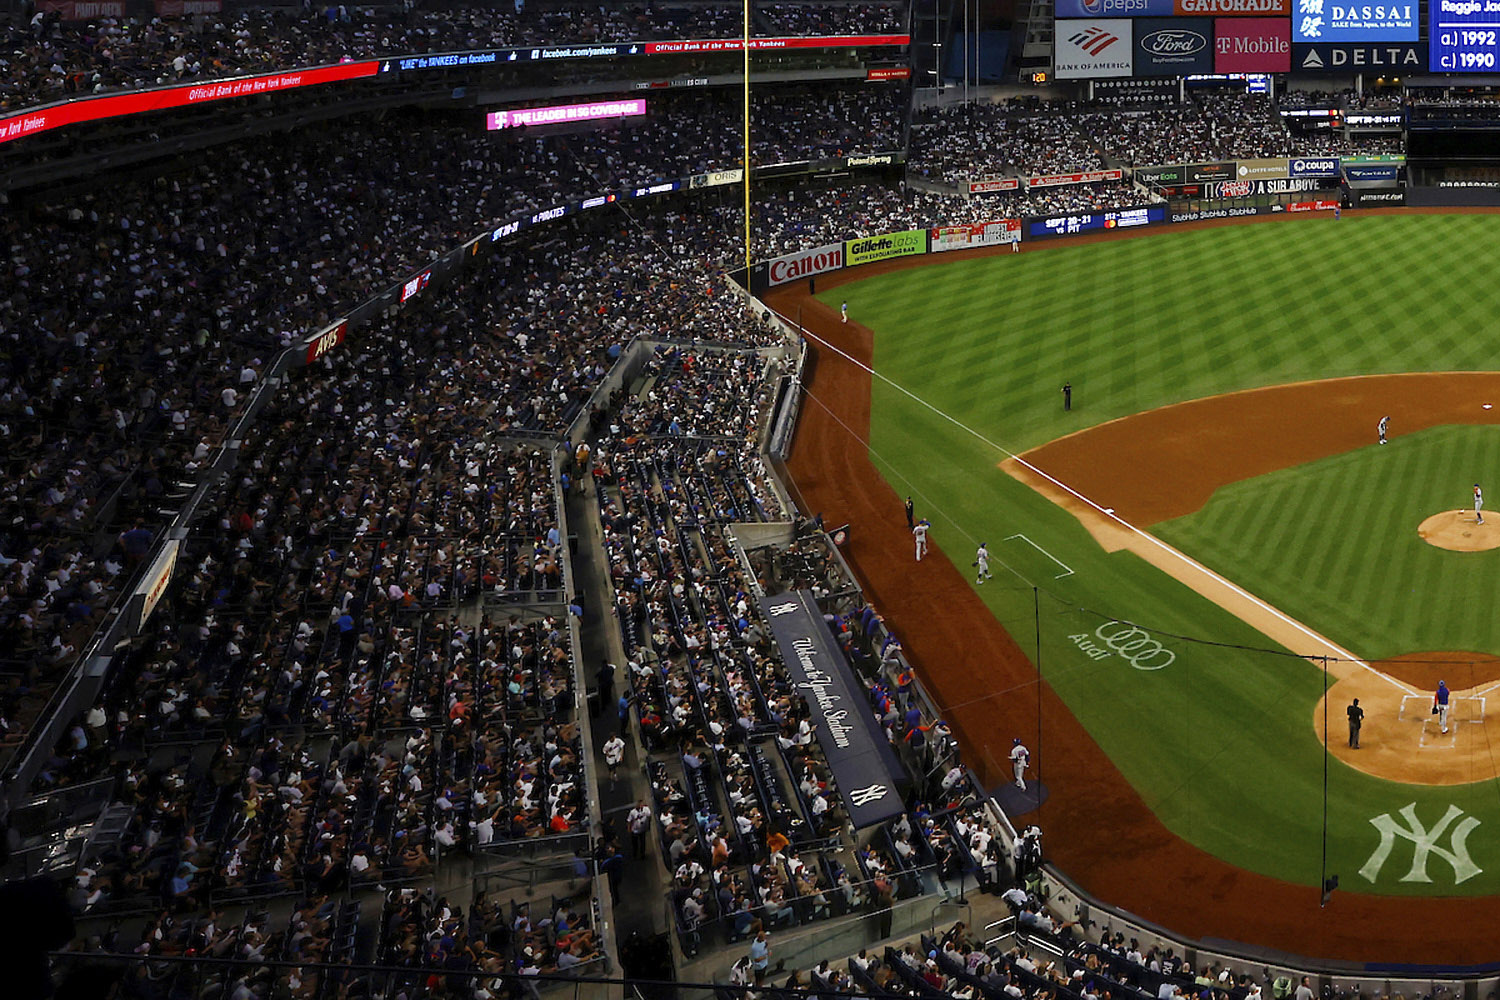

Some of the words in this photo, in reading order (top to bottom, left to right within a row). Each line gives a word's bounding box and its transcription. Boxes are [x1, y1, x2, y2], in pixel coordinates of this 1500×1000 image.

[1331, 5, 1412, 20] DASSAI
[1441, 0, 1482, 15] Reggie
[656, 42, 682, 51] Official
[684, 42, 700, 50] Bank
[702, 41, 709, 49] of
[711, 41, 722, 49] the
[759, 40, 785, 48] Yankees
[1151, 32, 1196, 53] Ford
[1234, 36, 1289, 54] Mobile
[1440, 30, 1458, 46] a.)
[1461, 31, 1496, 46] 1992
[542, 45, 617, 58] facebook.com/yankees
[1332, 49, 1420, 65] DELTA
[428, 55, 459, 67] YANKEES
[459, 56, 467, 65] on
[469, 52, 496, 63] facebook
[1056, 63, 1079, 71] BANK
[1092, 62, 1131, 70] AMERICA
[1440, 52, 1456, 69] c.)
[1459, 52, 1495, 68] 1990
[189, 86, 215, 100] Official
[216, 84, 232, 97] Bank
[233, 83, 241, 93] of
[241, 82, 252, 92] the
[254, 80, 265, 90] New
[267, 78, 279, 88] York
[281, 76, 302, 86] Yankees
[512, 112, 531, 125] THE
[533, 109, 566, 122] LEADER
[567, 108, 577, 118] IN
[590, 103, 638, 117] COVERAGE
[1305, 160, 1335, 171] coupa
[714, 169, 737, 182] ORIS
[1257, 182, 1265, 194] A
[1267, 180, 1287, 193] SUB
[1289, 179, 1320, 191] ABOVE
[538, 206, 565, 222] PIRATES
[1120, 209, 1148, 218] YANKEES
[1172, 213, 1198, 222] StubHub
[1200, 209, 1227, 219] StubHub
[1229, 207, 1256, 216] StubHub
[1045, 217, 1066, 228] SEPT
[1068, 224, 1080, 233] PIT
[851, 238, 892, 255] Gillette
[893, 231, 918, 247] labs
[770, 250, 841, 282] Canon
[314, 327, 339, 357] AVIS
[1067, 633, 1111, 660] Audi
